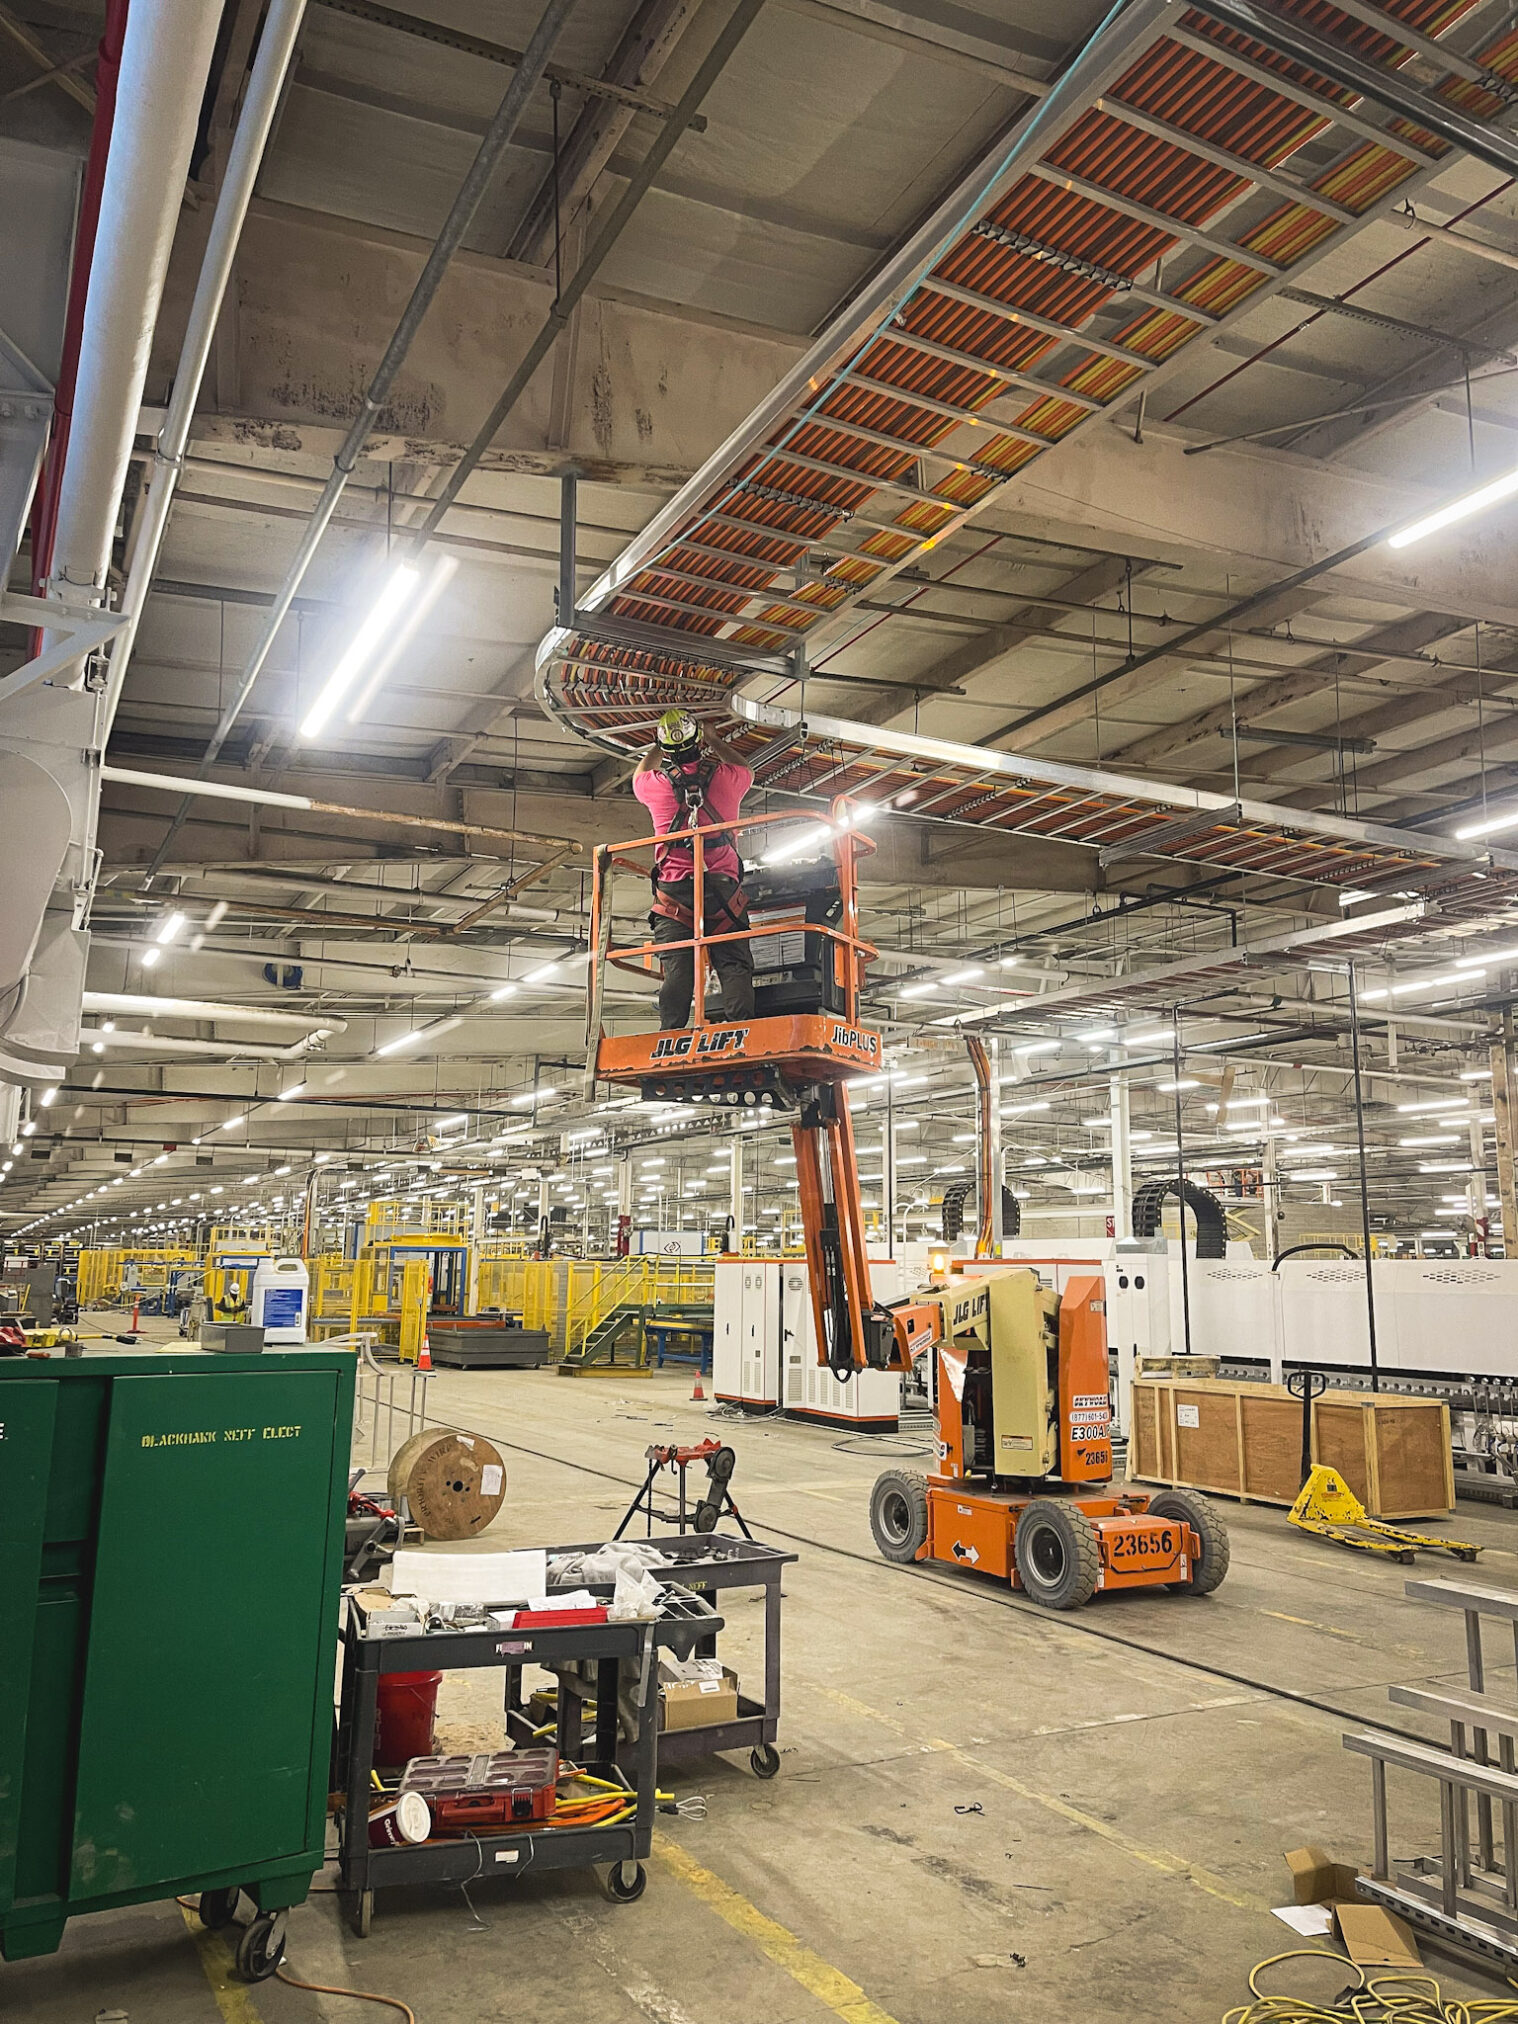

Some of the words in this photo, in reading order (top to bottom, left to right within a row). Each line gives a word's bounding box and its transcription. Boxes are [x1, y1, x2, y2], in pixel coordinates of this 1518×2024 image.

[650, 1035, 693, 1060] JLG
[697, 1028, 749, 1053] LIFT
[831, 1024, 877, 1054] JibPLUS
[953, 1300, 970, 1326] JLG
[223, 1428, 256, 1442] NEFF
[262, 1425, 302, 1440] ELECT
[1113, 1530, 1173, 1558] 23656
